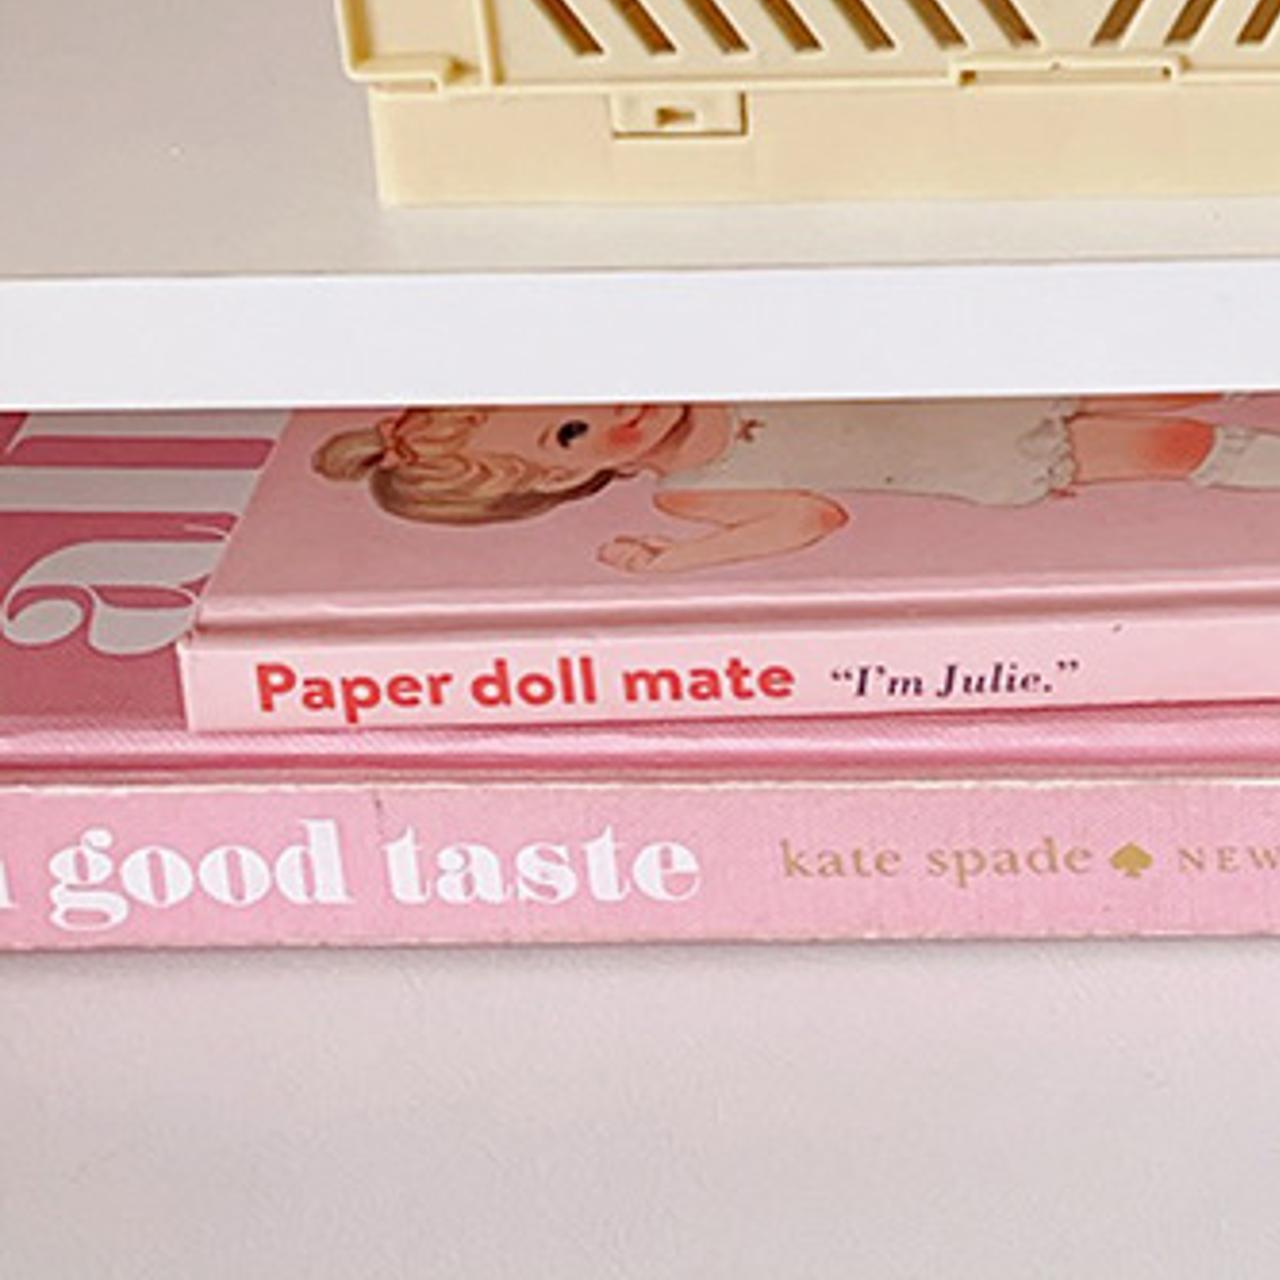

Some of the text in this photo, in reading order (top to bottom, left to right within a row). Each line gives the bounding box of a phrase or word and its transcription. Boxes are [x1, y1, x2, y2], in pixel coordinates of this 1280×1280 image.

[255, 662, 453, 726] Paper
[470, 655, 598, 709] doll
[622, 657, 796, 703] mate
[46, 819, 353, 931] good
[376, 825, 700, 905] taste
[780, 838, 902, 878] kate
[926, 836, 1092, 888] spade
